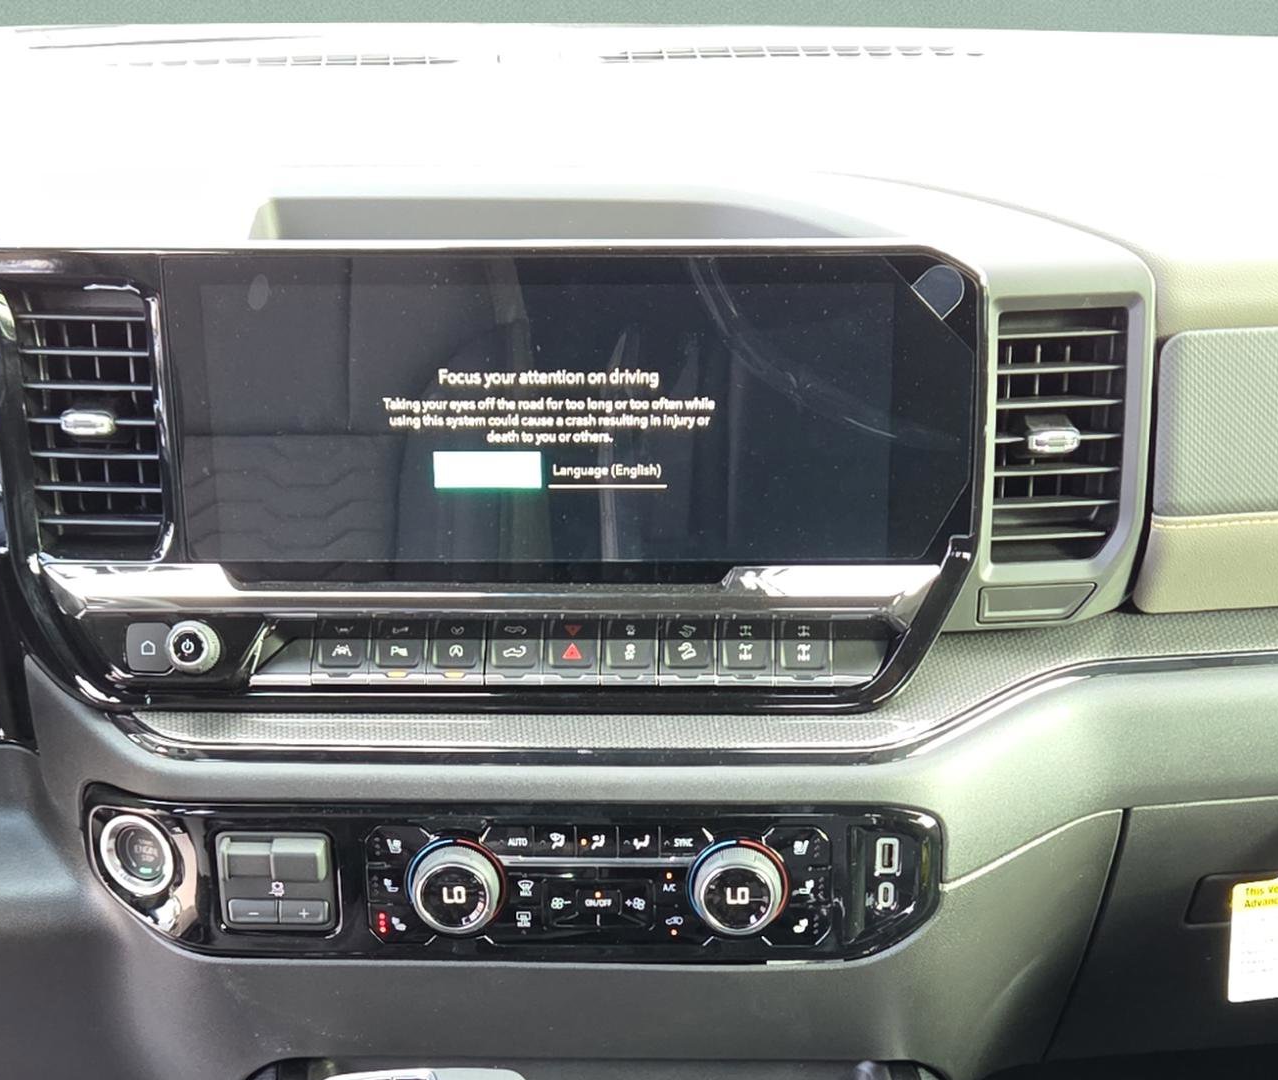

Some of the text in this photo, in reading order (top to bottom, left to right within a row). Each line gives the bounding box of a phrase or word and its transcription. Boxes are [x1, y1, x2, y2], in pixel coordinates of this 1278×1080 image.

[437, 367, 659, 389] Focus your attention on driving
[382, 397, 716, 413] Taking your eyes off the road for too long or too often while
[389, 414, 710, 430] using this system could cause a crash resulting in injury or
[486, 430, 614, 446] death to you or others.
[552, 463, 662, 479] Language (English)
[507, 837, 528, 847] AUTO
[673, 838, 694, 848] SYNC
[442, 885, 466, 904] LO
[662, 883, 677, 892] A/C
[726, 886, 750, 905] LO
[1245, 887, 1265, 896] This
[584, 899, 613, 907] ON/OFF
